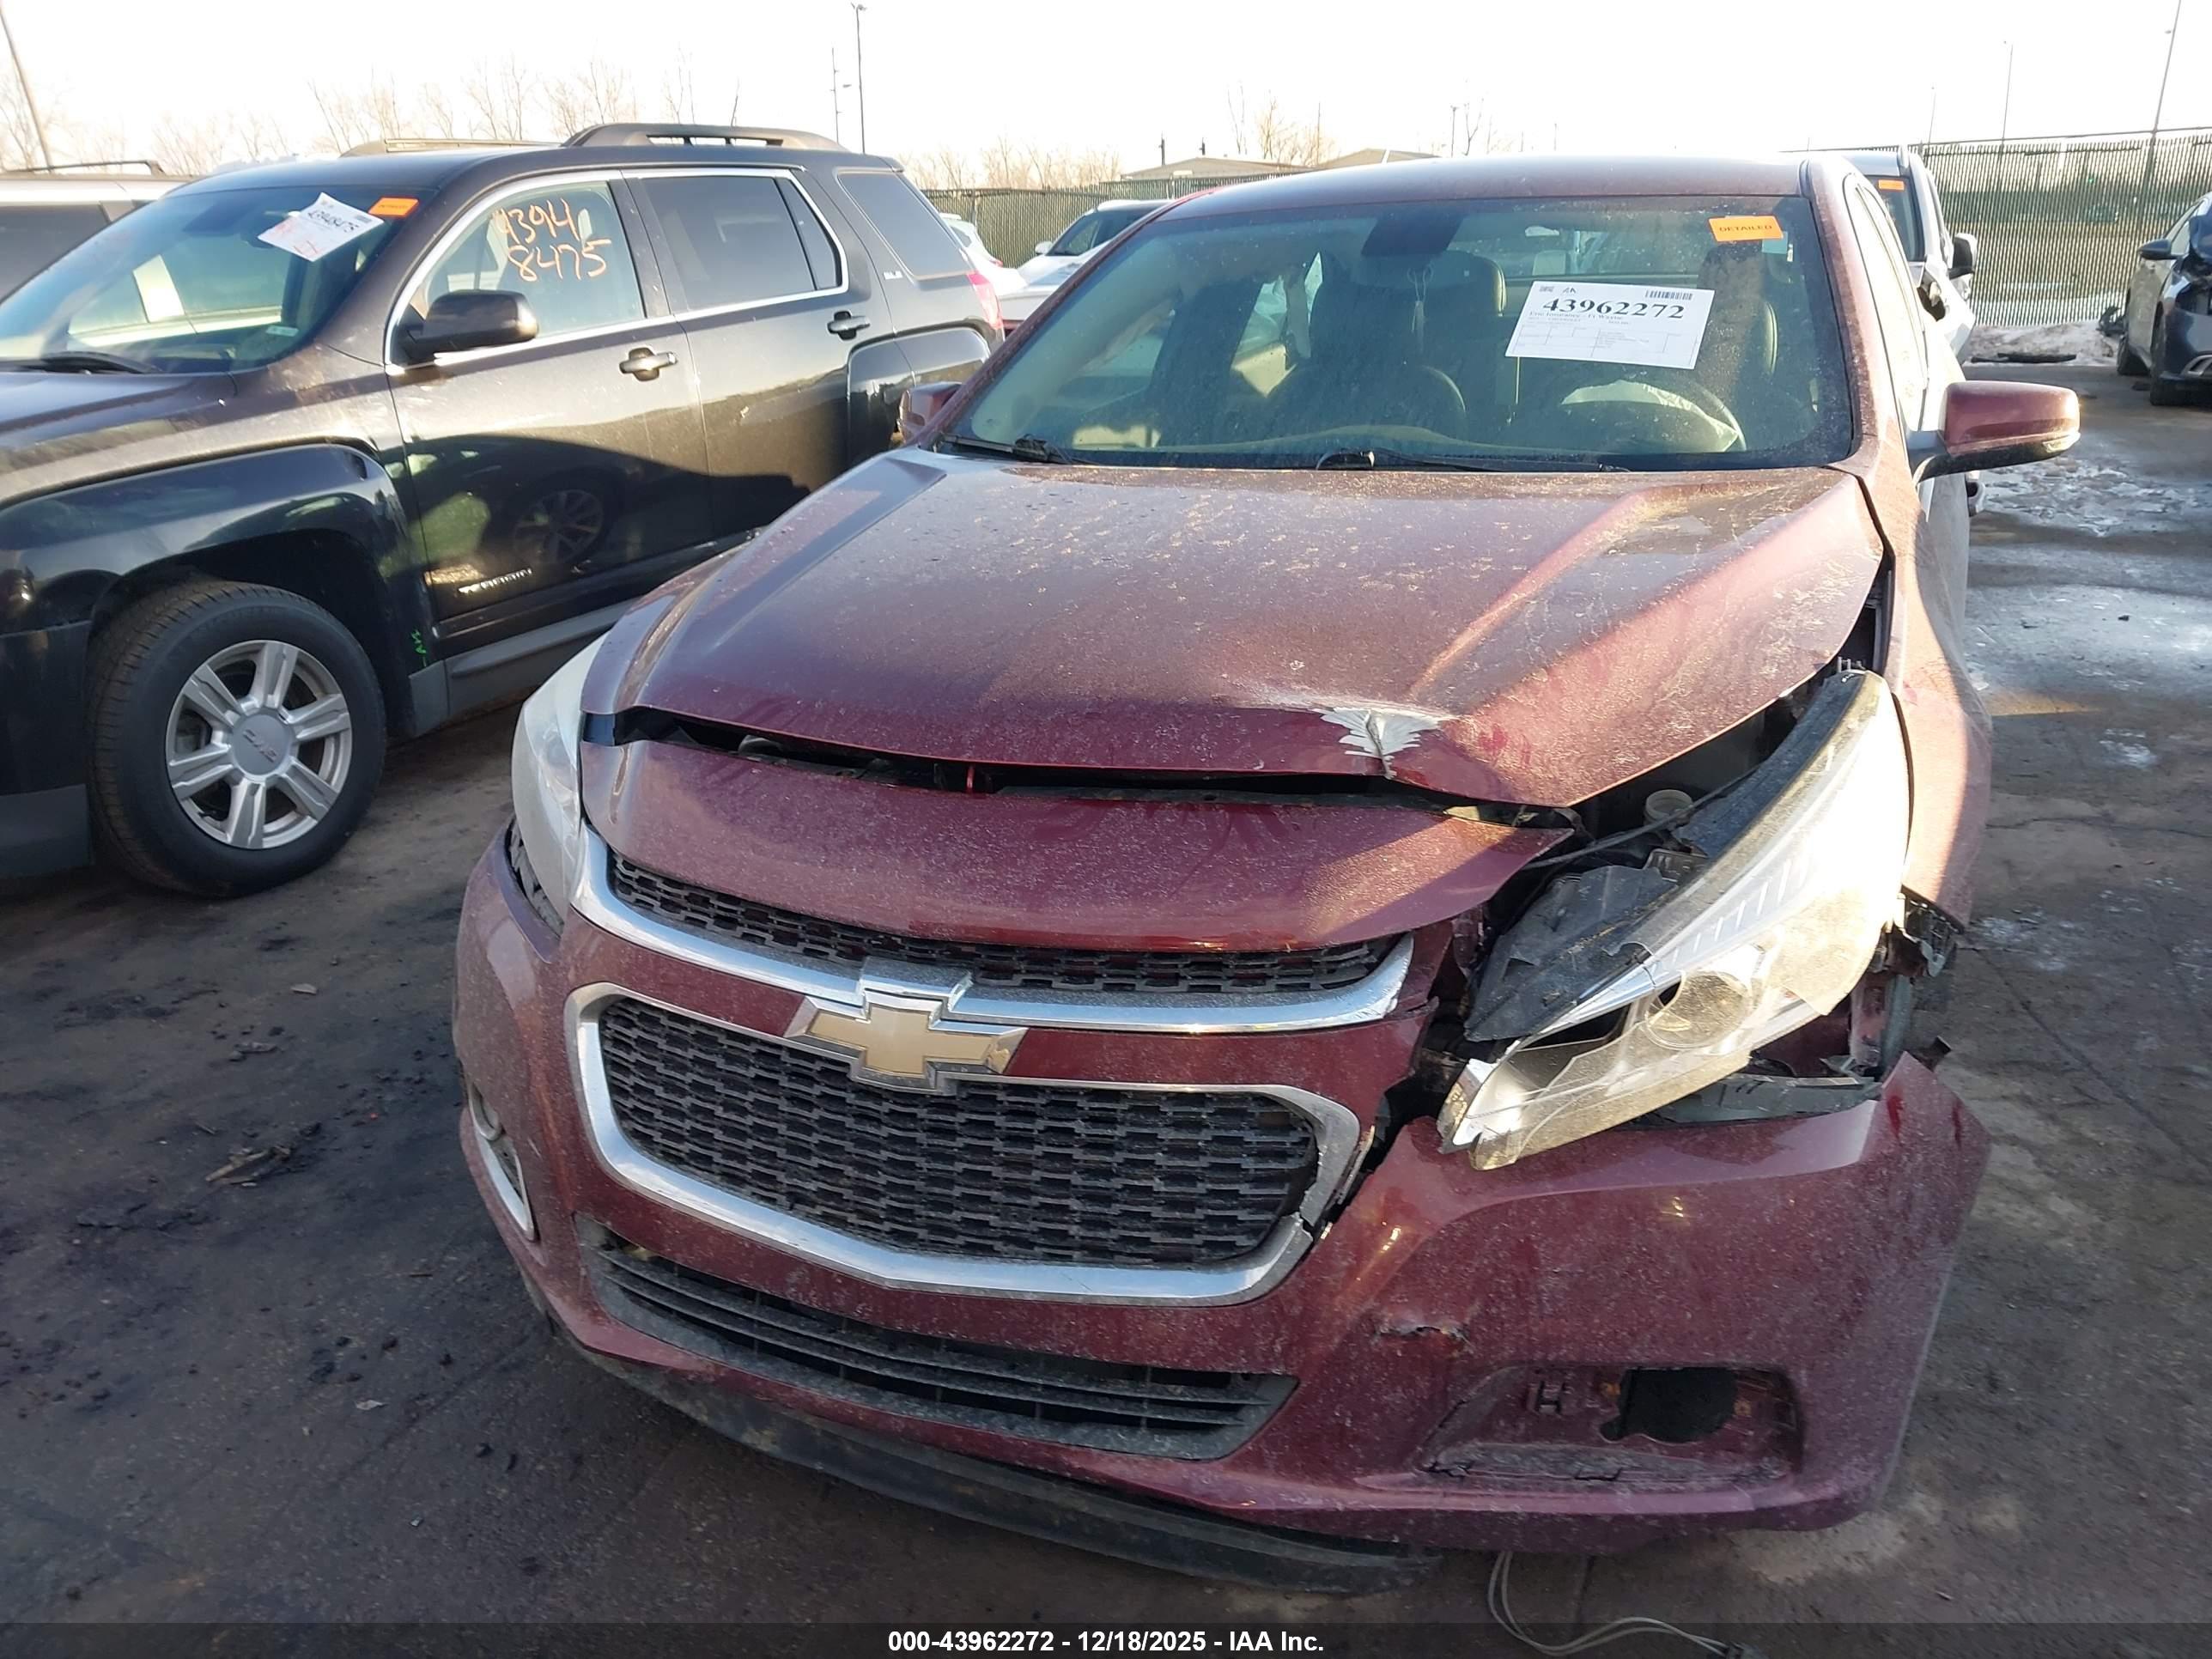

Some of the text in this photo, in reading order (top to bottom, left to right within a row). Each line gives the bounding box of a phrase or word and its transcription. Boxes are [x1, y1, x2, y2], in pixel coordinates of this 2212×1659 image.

[492, 198, 580, 245] 4394
[507, 239, 612, 282] 8475
[1542, 298, 1685, 319] 43962272
